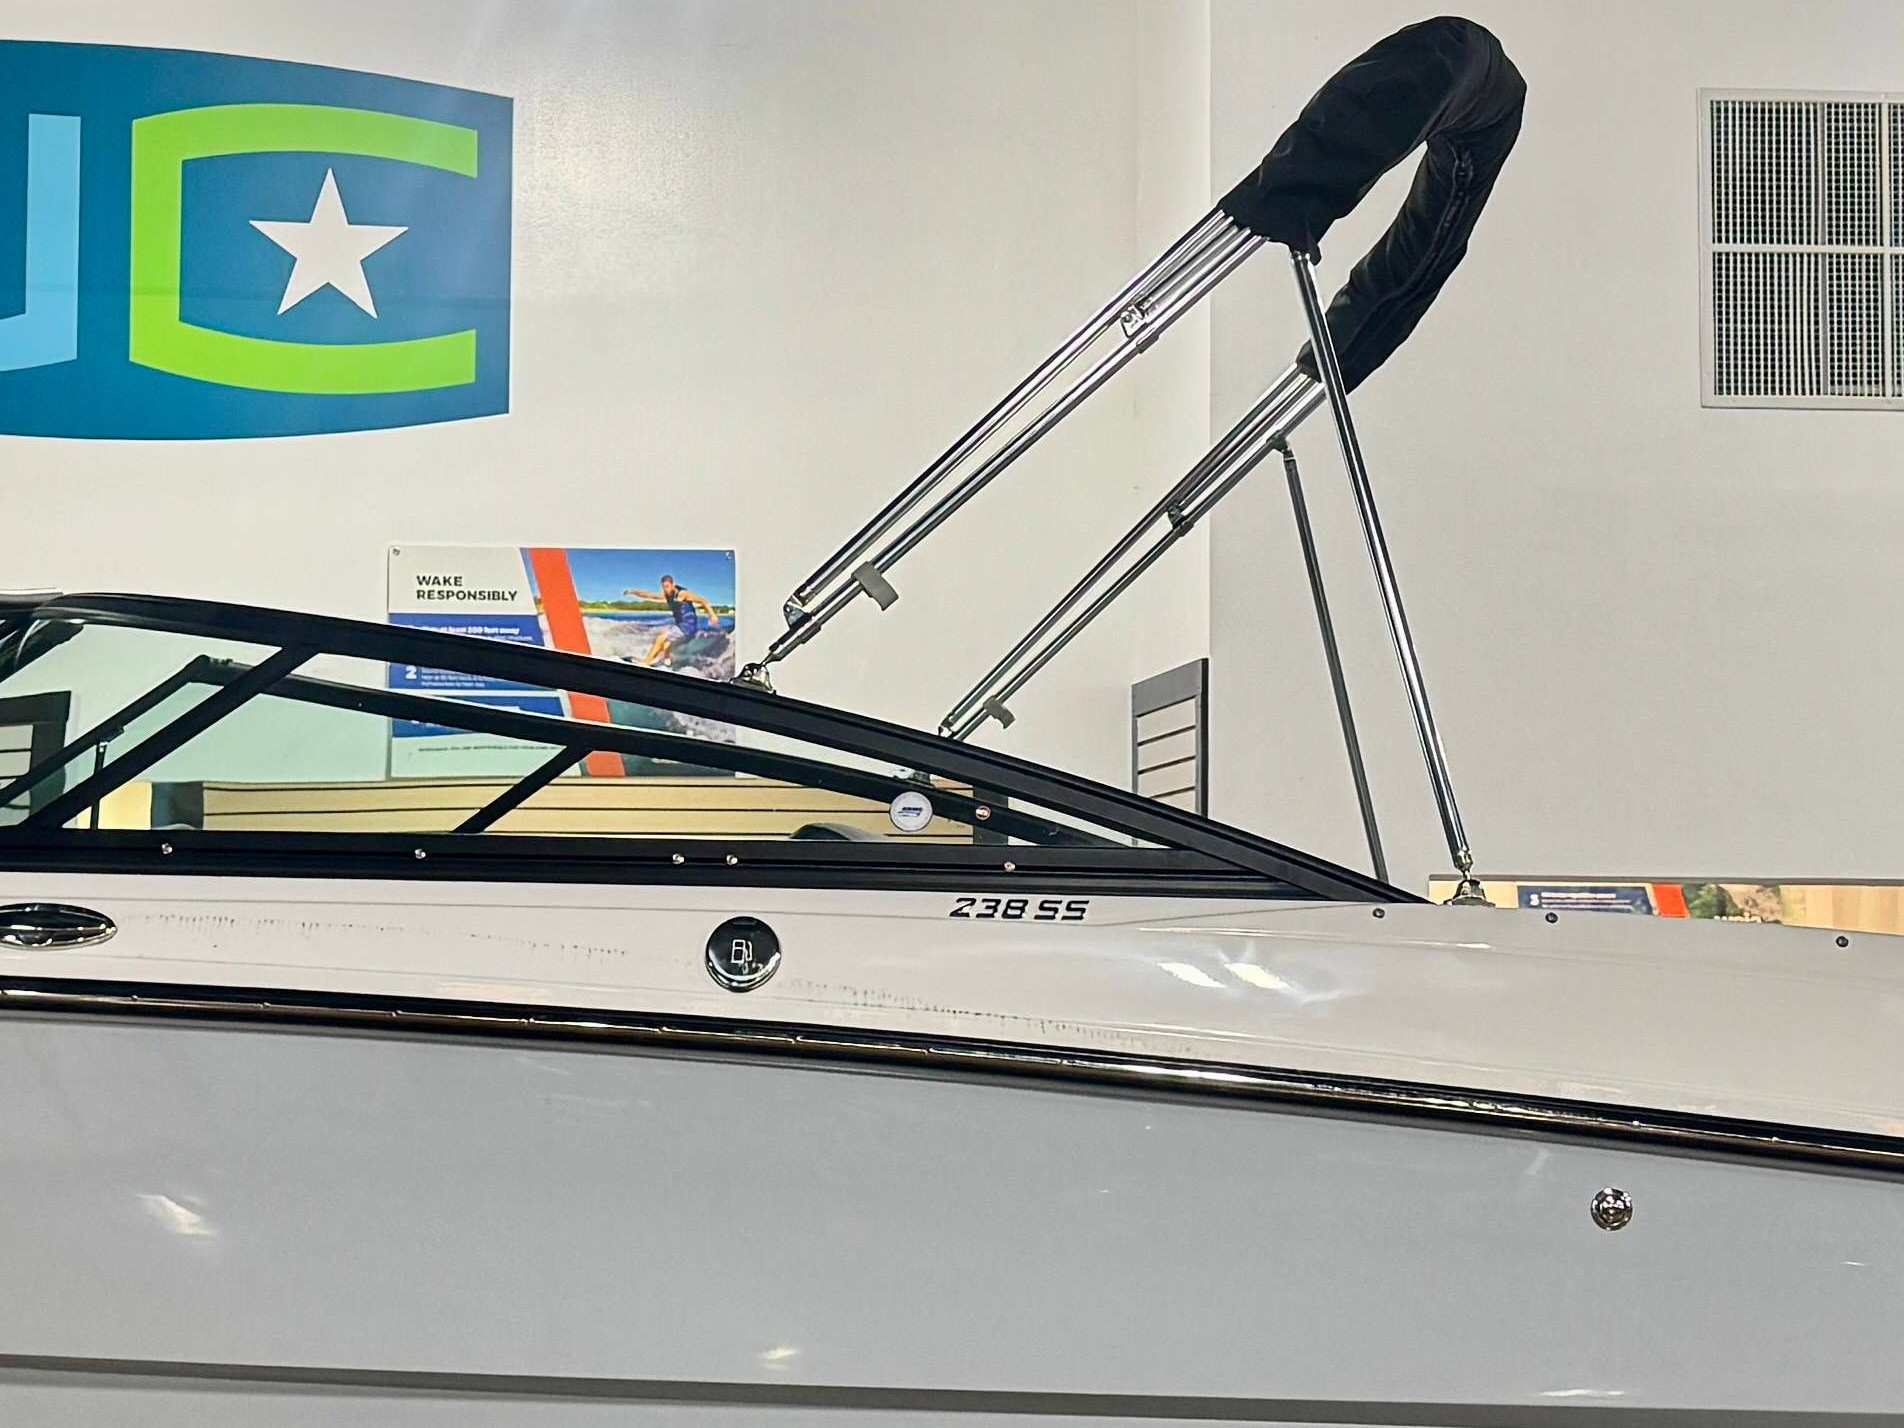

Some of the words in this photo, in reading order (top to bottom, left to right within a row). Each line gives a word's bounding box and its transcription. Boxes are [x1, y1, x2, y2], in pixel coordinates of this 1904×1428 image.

[416, 575, 463, 586] WAKE
[416, 589, 518, 601] RESPONSIBLY
[405, 665, 417, 679] 2
[949, 897, 1029, 919] 238
